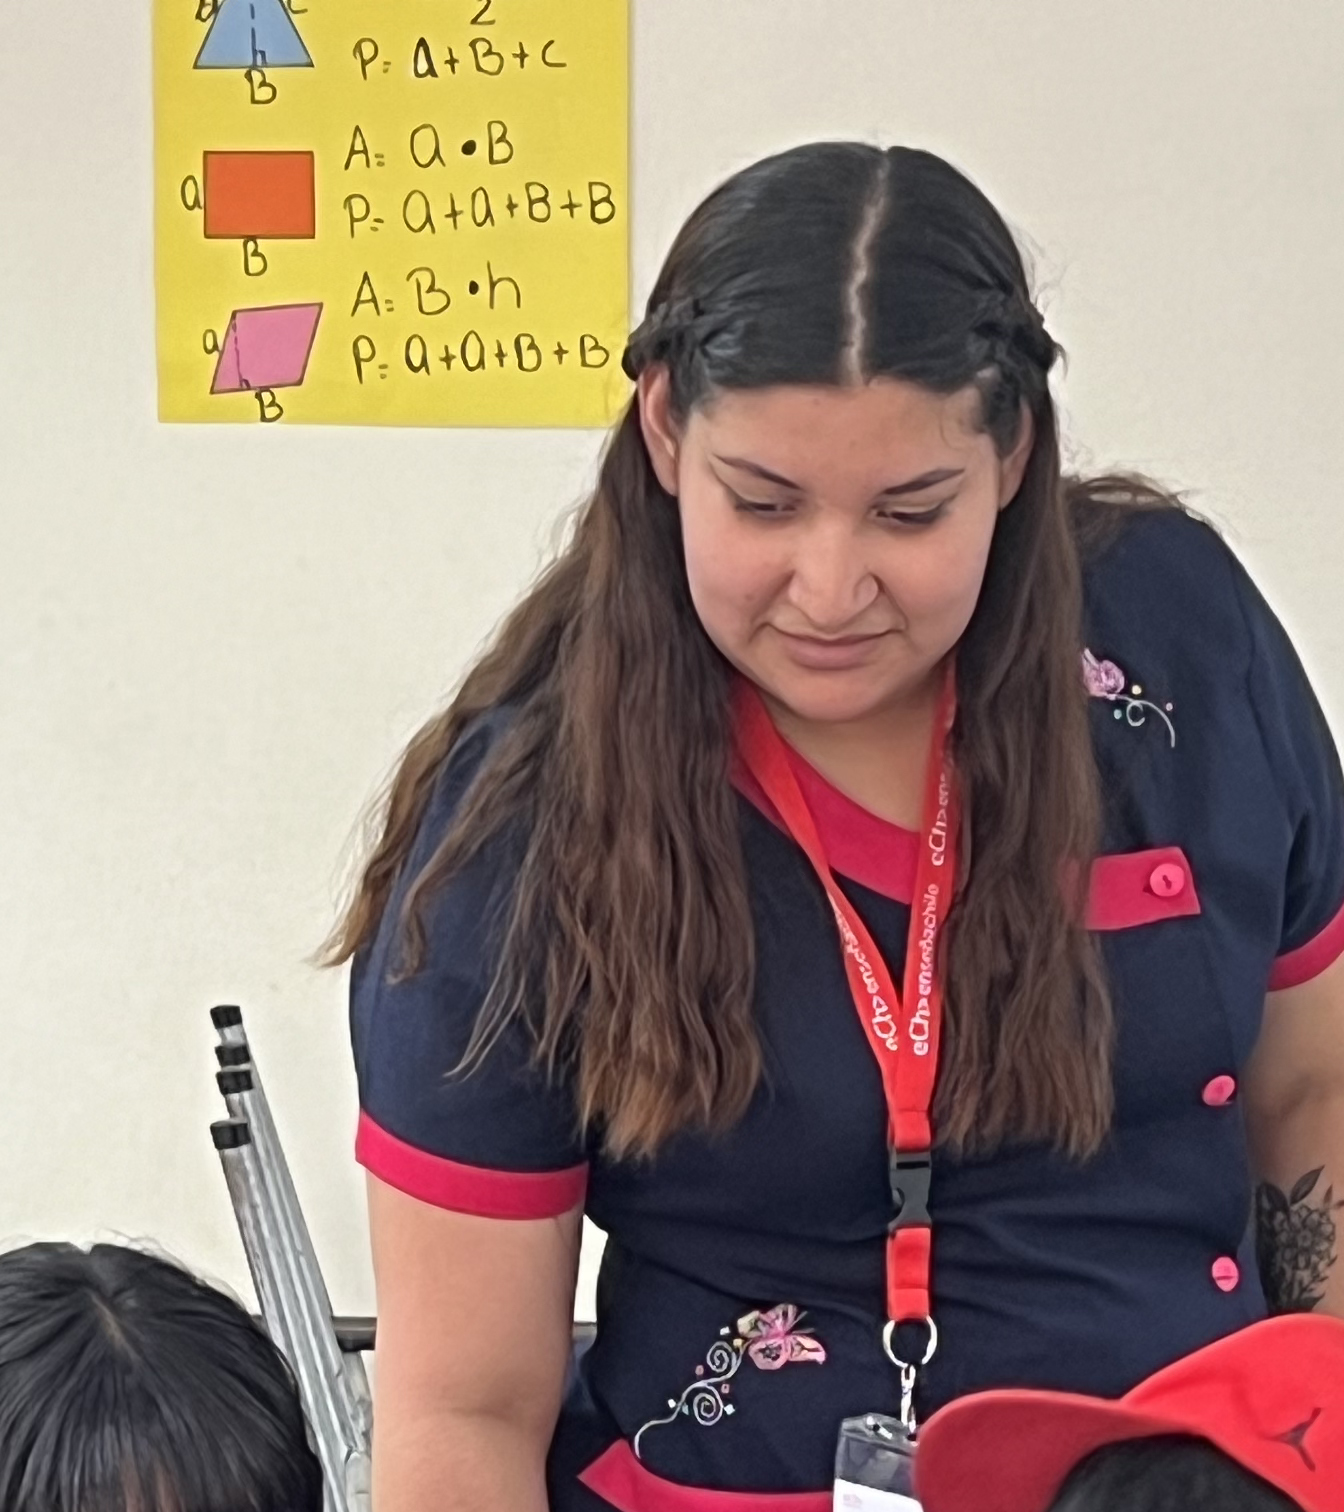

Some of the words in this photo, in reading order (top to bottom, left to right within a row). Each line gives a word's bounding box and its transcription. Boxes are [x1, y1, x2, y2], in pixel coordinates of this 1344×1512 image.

[244, 67, 278, 105] B
[242, 236, 269, 277] B
[254, 387, 285, 423] B
